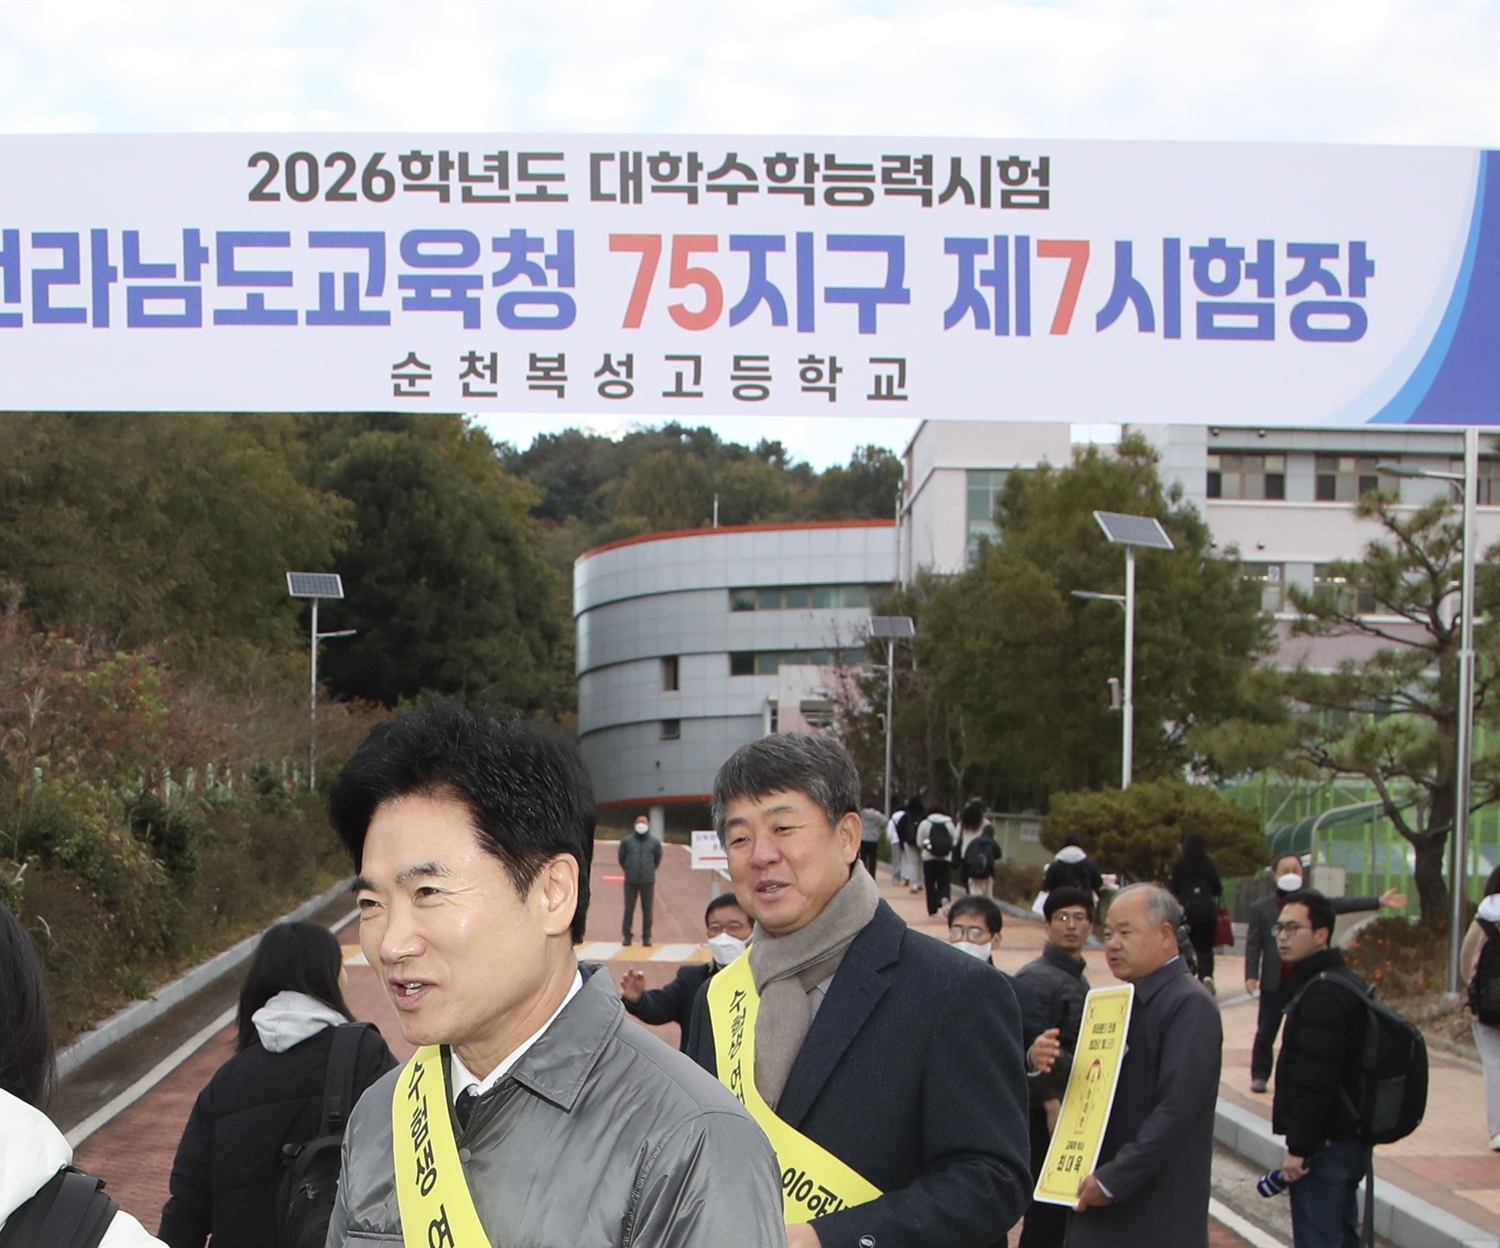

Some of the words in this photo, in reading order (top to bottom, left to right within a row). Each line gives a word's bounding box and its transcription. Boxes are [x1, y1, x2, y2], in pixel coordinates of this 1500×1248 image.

[247, 150, 569, 204] 2026학년도
[589, 150, 1051, 211] 대학수학능력시험
[608, 231, 911, 334] 75지구
[943, 235, 1376, 343] 제7시험장
[390, 351, 909, 402] 순천복성고등학교
[406, 1060, 437, 1198] 수험생
